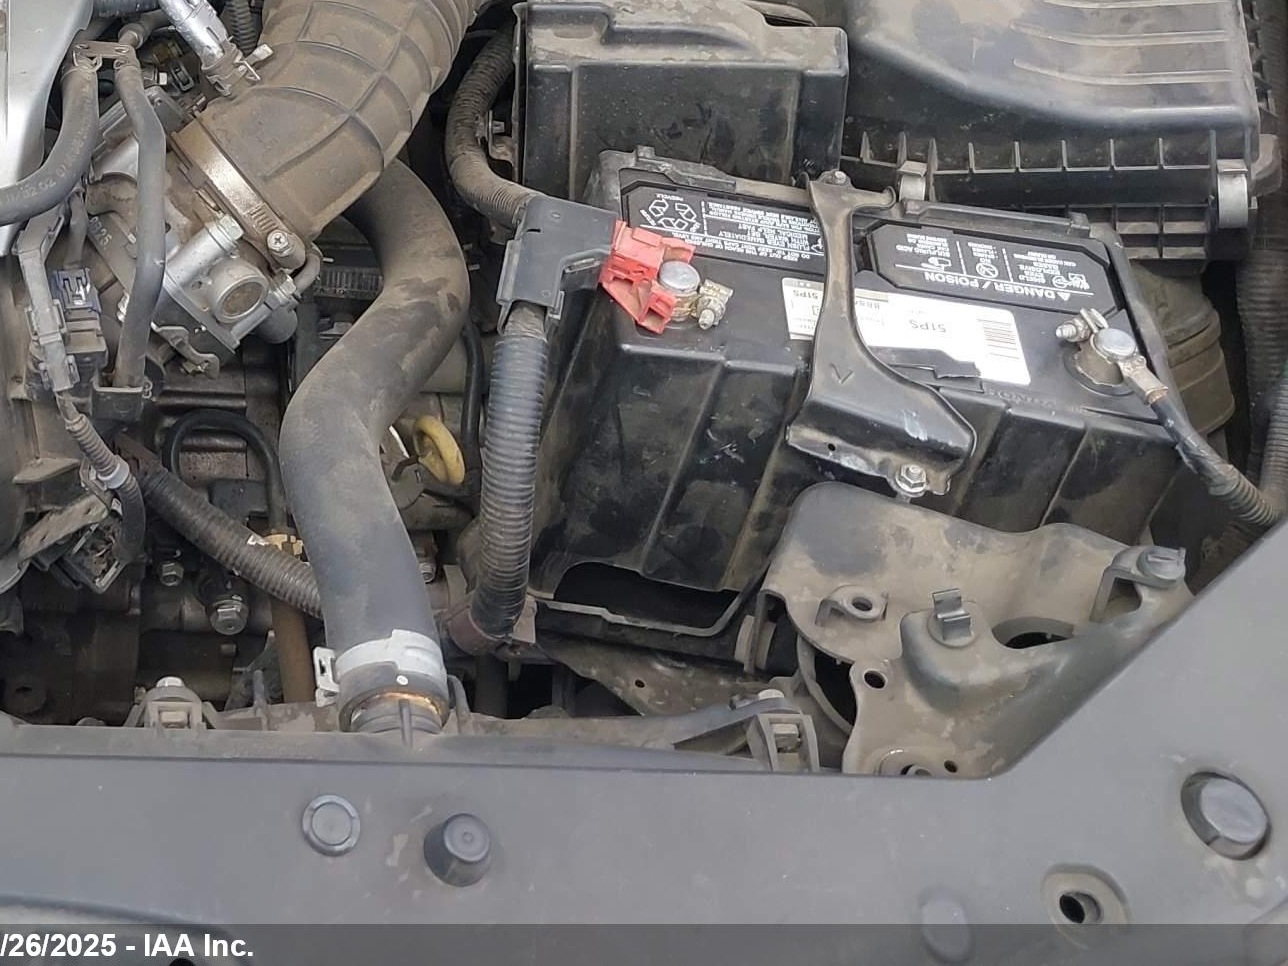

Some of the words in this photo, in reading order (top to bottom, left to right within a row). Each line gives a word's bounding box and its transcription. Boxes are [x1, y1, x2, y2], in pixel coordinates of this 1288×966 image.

[718, 230, 765, 243] IMMEDIATELY
[766, 238, 785, 247] EYES
[786, 242, 809, 251] FLUSH
[924, 271, 979, 287] POISON
[791, 289, 818, 299] 51PS
[993, 282, 1054, 298] DANGER
[907, 319, 946, 332] 51PS
